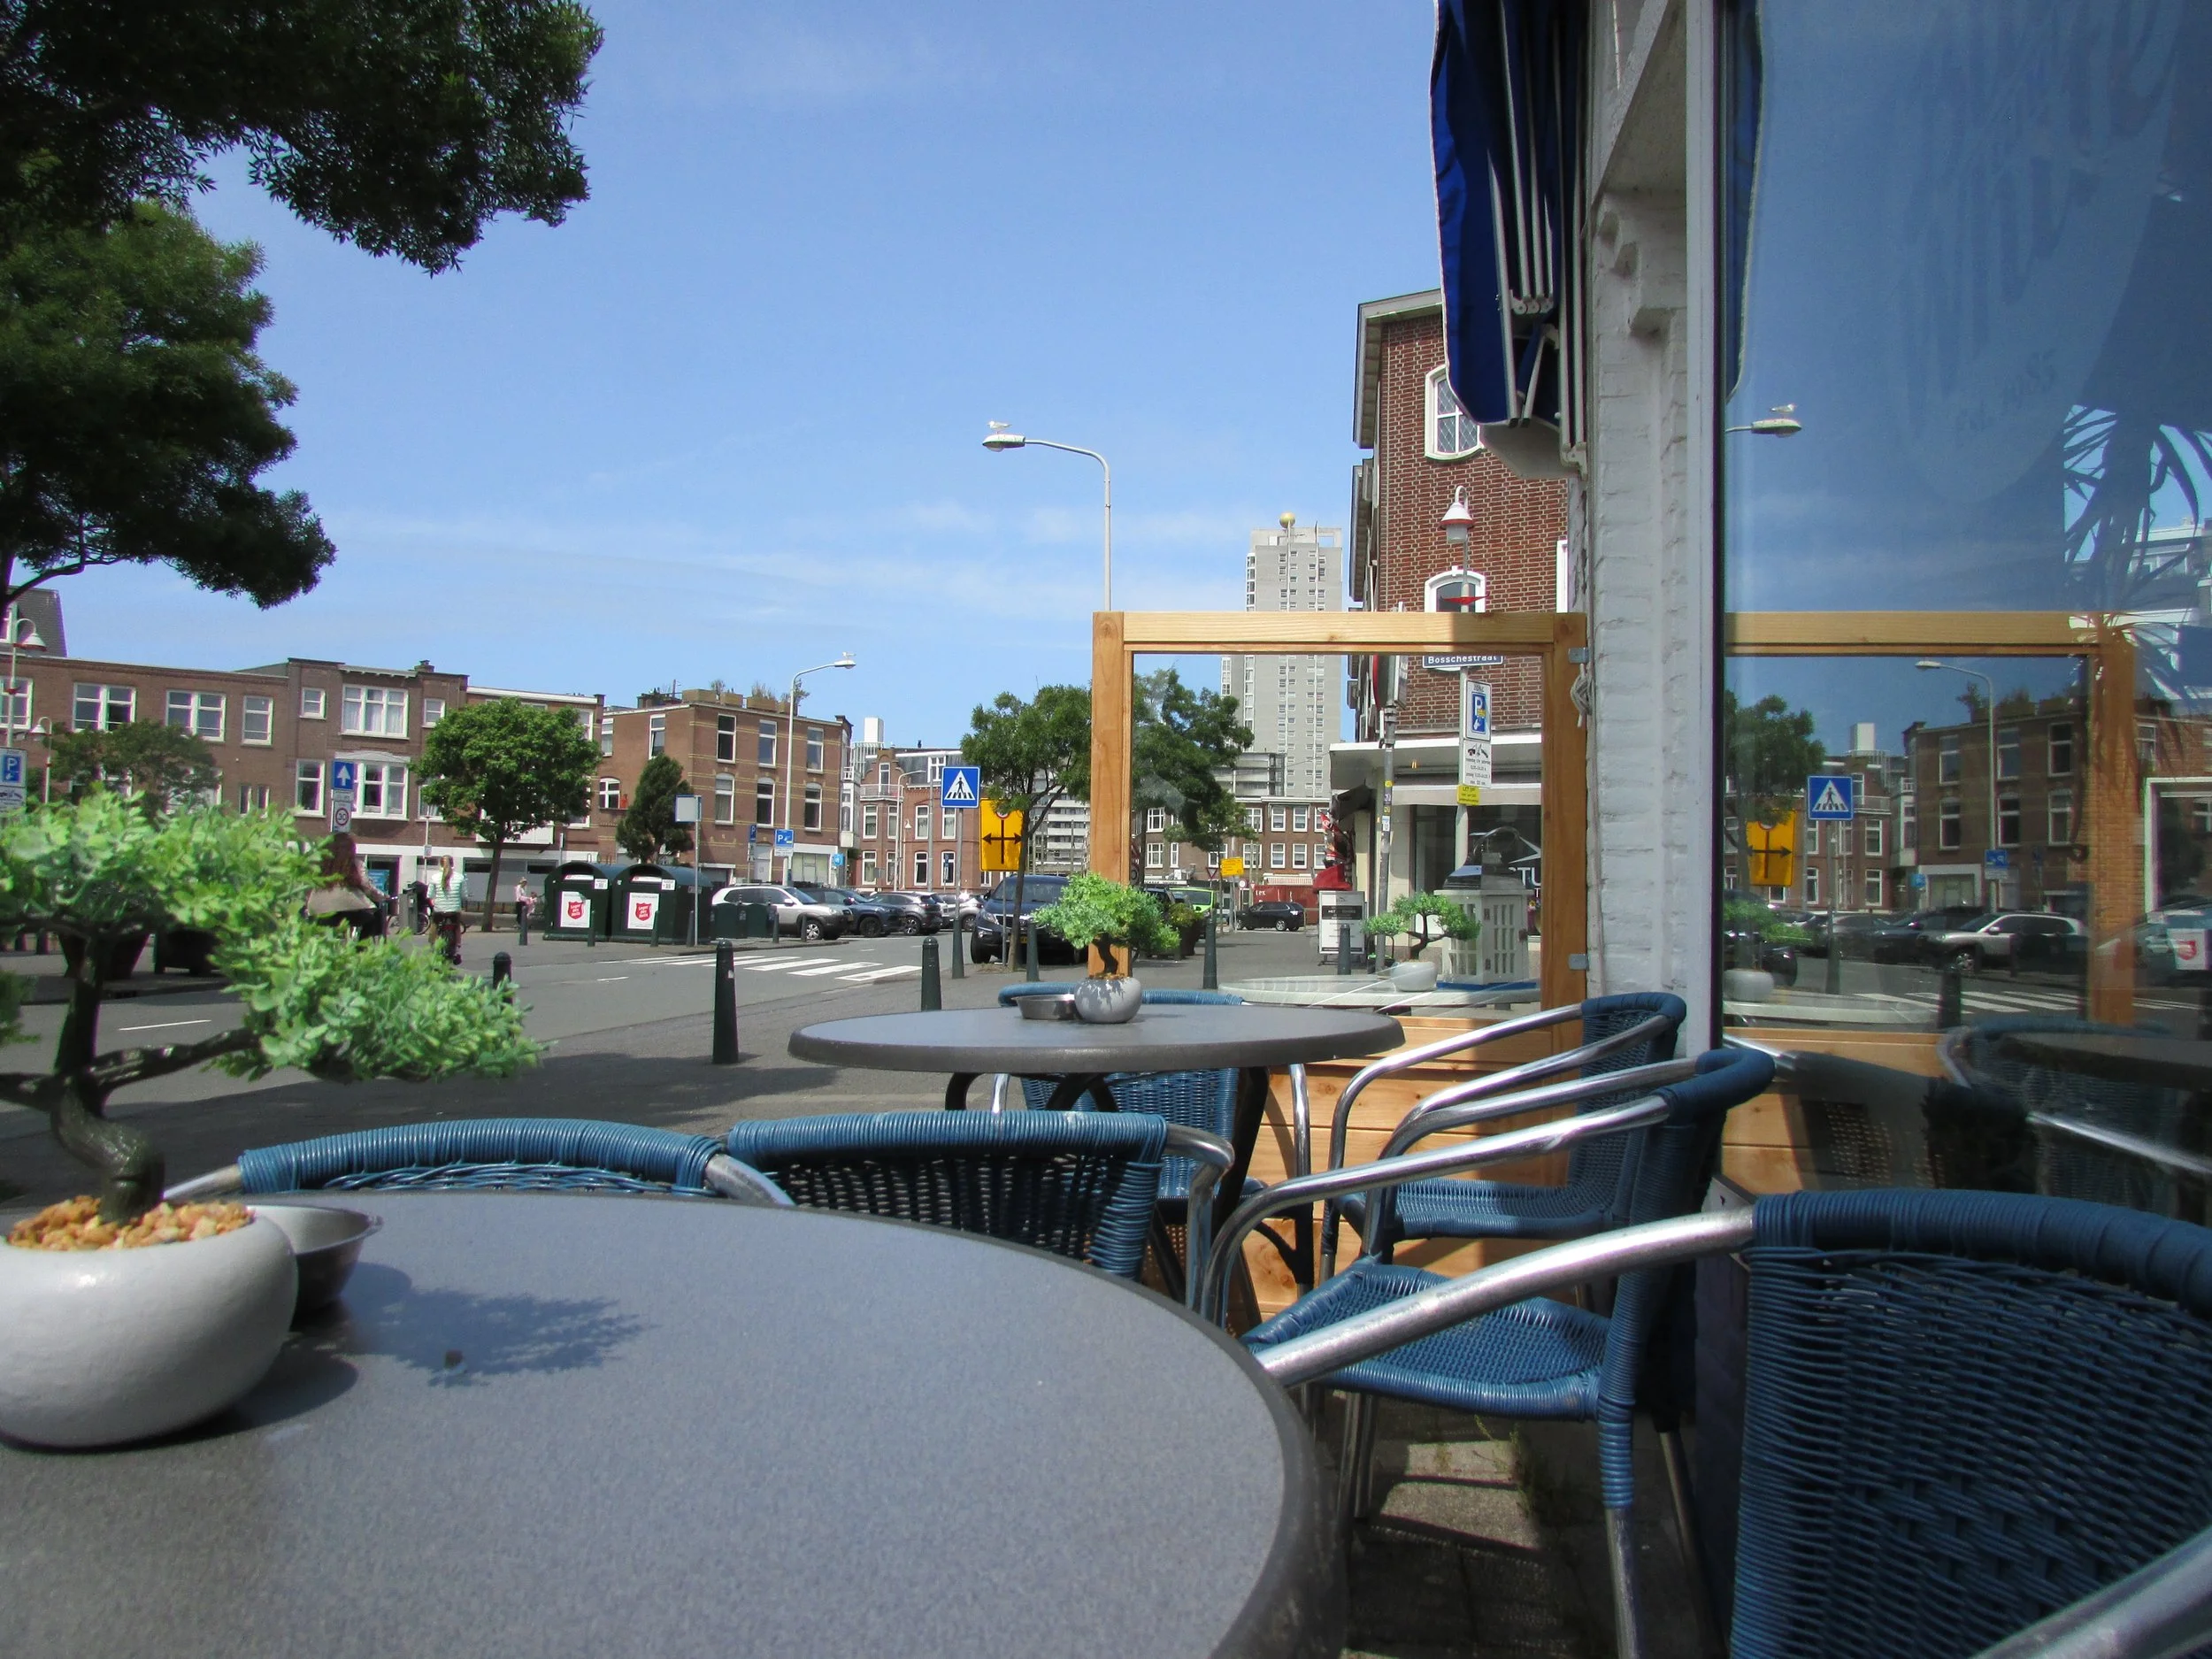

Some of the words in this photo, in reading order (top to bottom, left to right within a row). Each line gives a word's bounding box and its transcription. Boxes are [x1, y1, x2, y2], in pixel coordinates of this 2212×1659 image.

[1428, 655, 1497, 664] Bosschestraat
[1474, 696, 1483, 716] P
[7, 757, 18, 771] P
